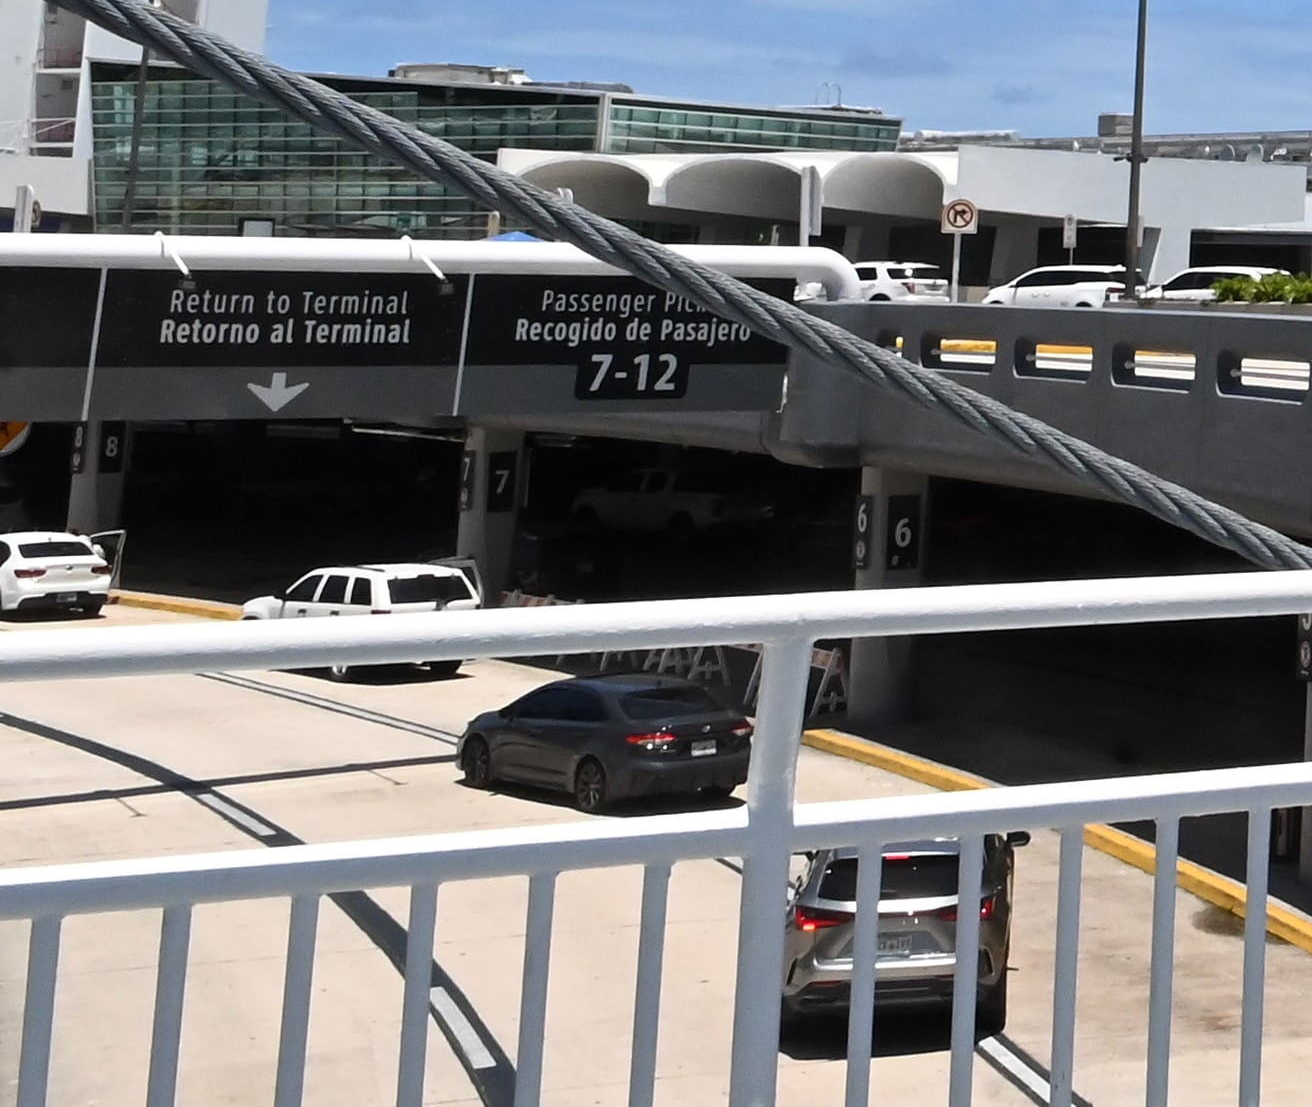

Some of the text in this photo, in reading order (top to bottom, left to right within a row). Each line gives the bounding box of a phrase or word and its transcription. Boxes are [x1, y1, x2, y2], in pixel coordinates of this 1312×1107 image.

[170, 289, 408, 315] Return to Terminal
[541, 289, 656, 318] Passenger
[160, 318, 411, 344] Retorno al Terminal
[515, 317, 751, 347] Recogido de Pasajero
[588, 353, 678, 392] 7-12
[105, 436, 119, 457] 8
[495, 470, 510, 494] 7
[857, 503, 867, 533] 6
[894, 517, 912, 548] 6
